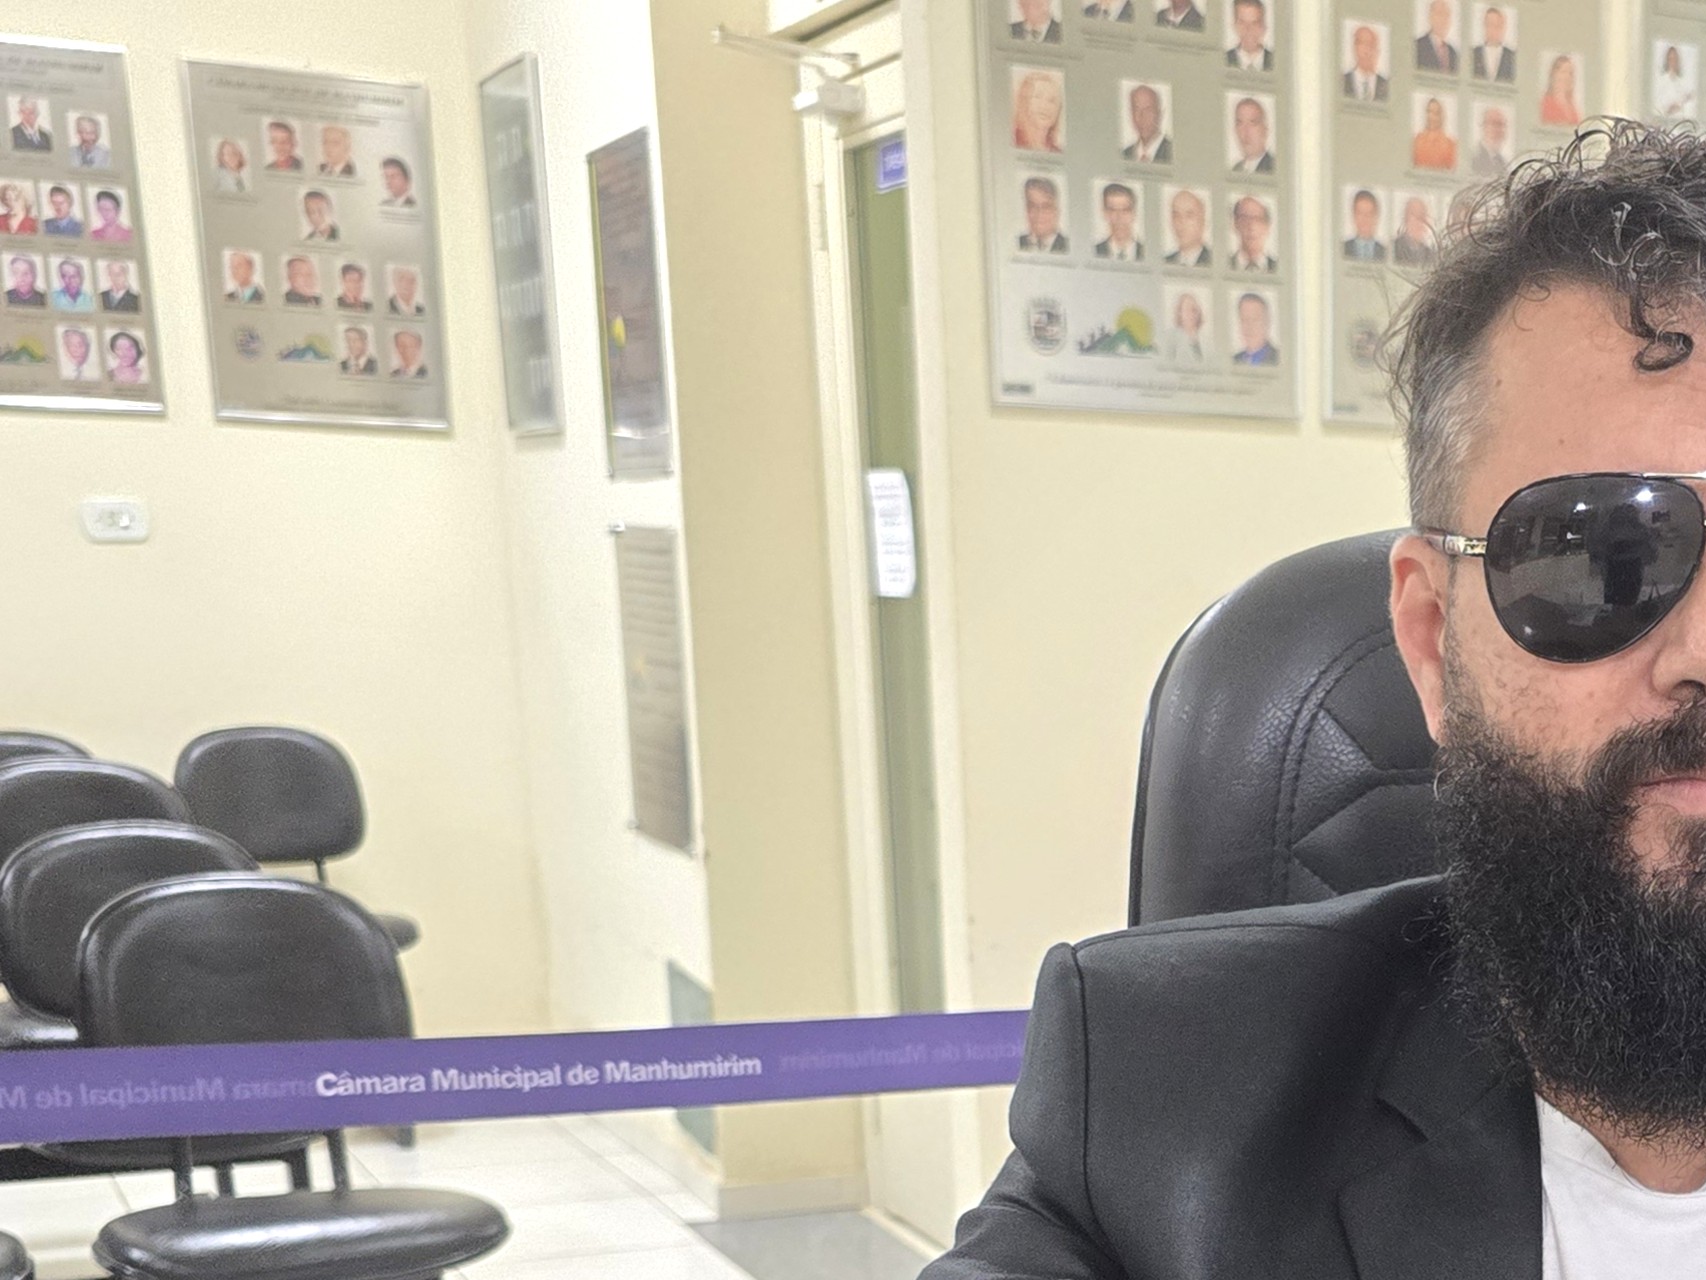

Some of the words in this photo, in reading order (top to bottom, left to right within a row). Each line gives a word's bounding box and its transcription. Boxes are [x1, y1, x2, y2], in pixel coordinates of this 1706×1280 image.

[315, 1070, 426, 1096] Câmara
[431, 1062, 562, 1092] Municipal
[565, 1062, 599, 1086] de
[604, 1053, 762, 1084] Manhumirim
